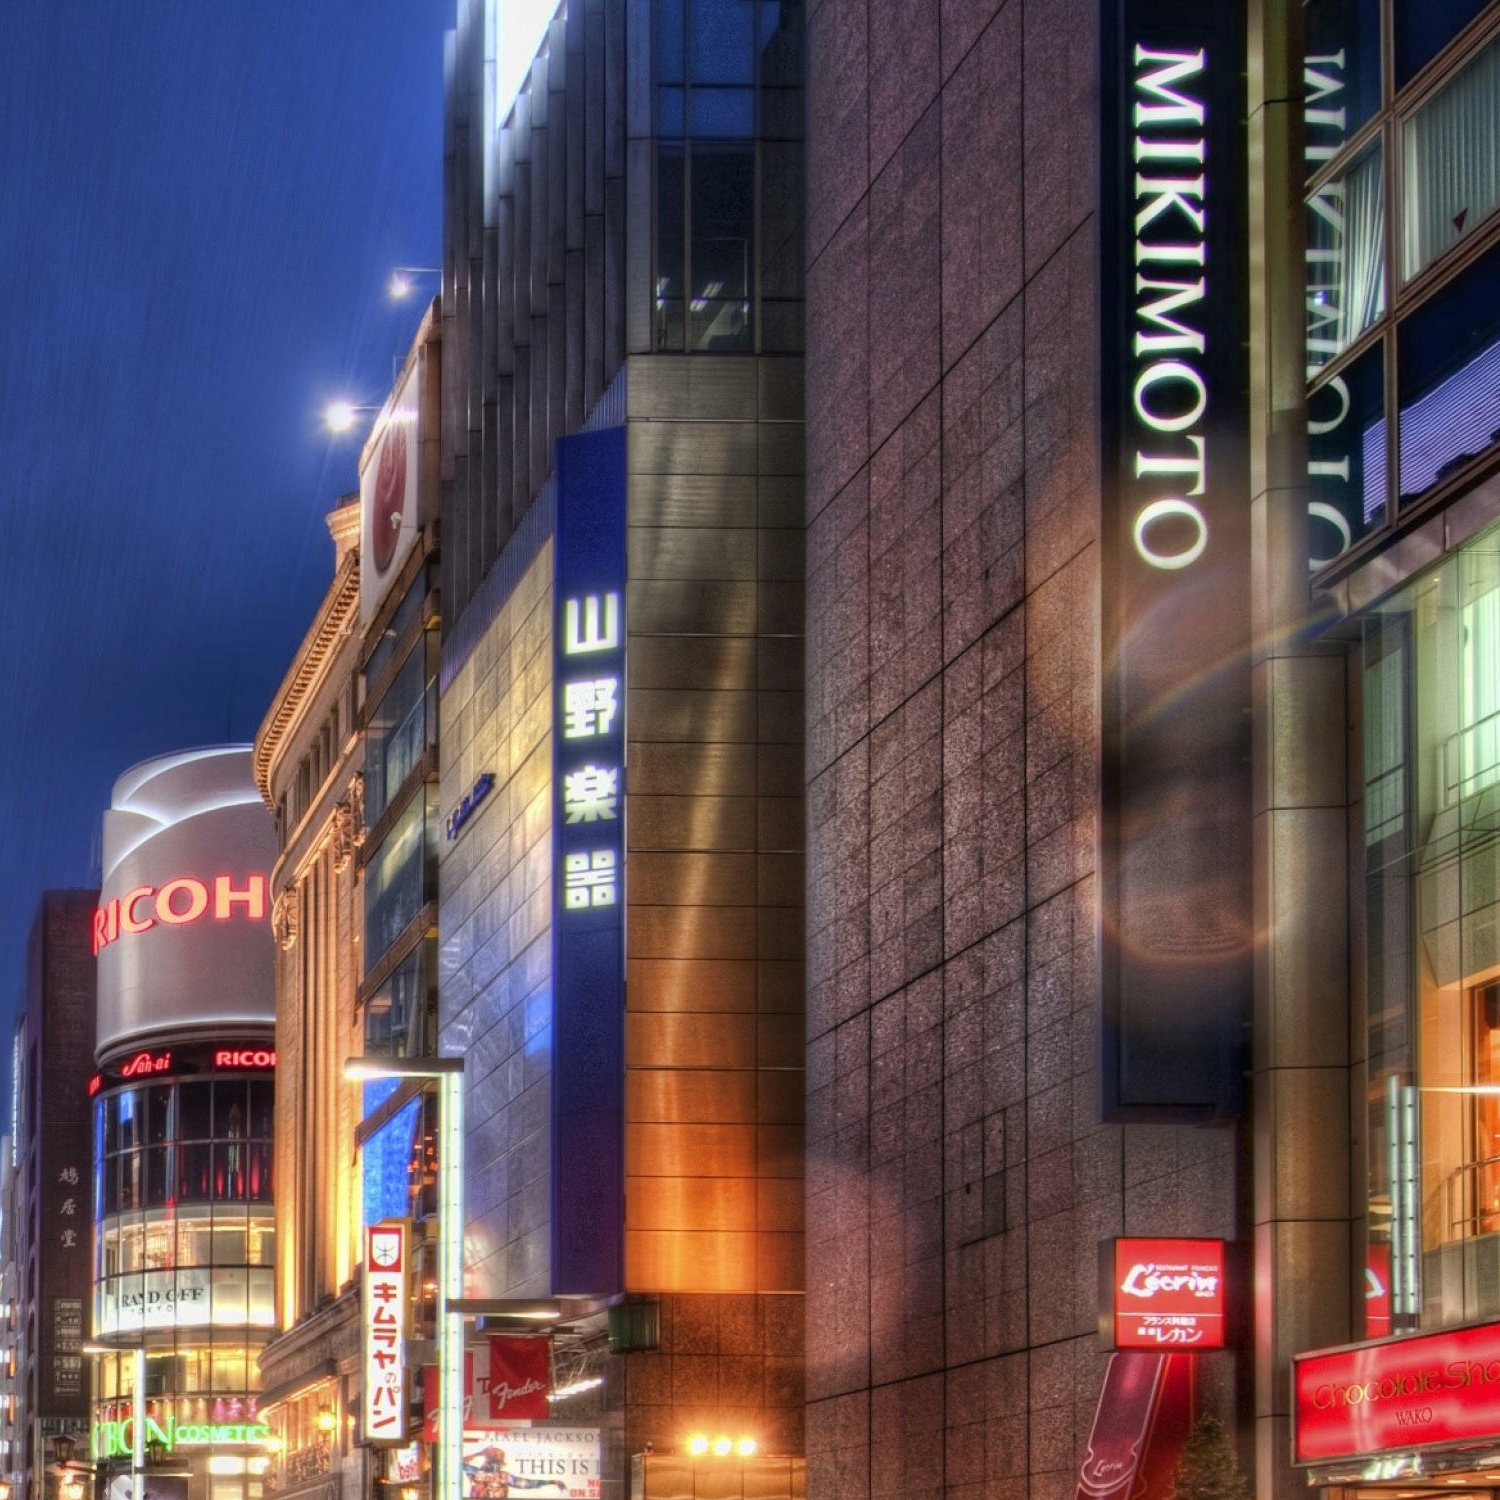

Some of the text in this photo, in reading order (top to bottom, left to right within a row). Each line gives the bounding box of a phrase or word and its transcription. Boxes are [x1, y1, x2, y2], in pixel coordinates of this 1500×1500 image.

[1133, 44, 1208, 570] MIKIMOTO
[563, 592, 619, 911] 山野楽器
[92, 875, 266, 957] RICOH
[372, 1282, 401, 1429] キムラヤのパン
[491, 1376, 547, 1411] Fender
[1312, 1368, 1442, 1410] Chocolate
[1395, 1405, 1434, 1426] WAKO
[536, 1431, 600, 1443] JACKSO
[516, 1458, 565, 1475] THIS
[571, 1458, 590, 1475] IS
